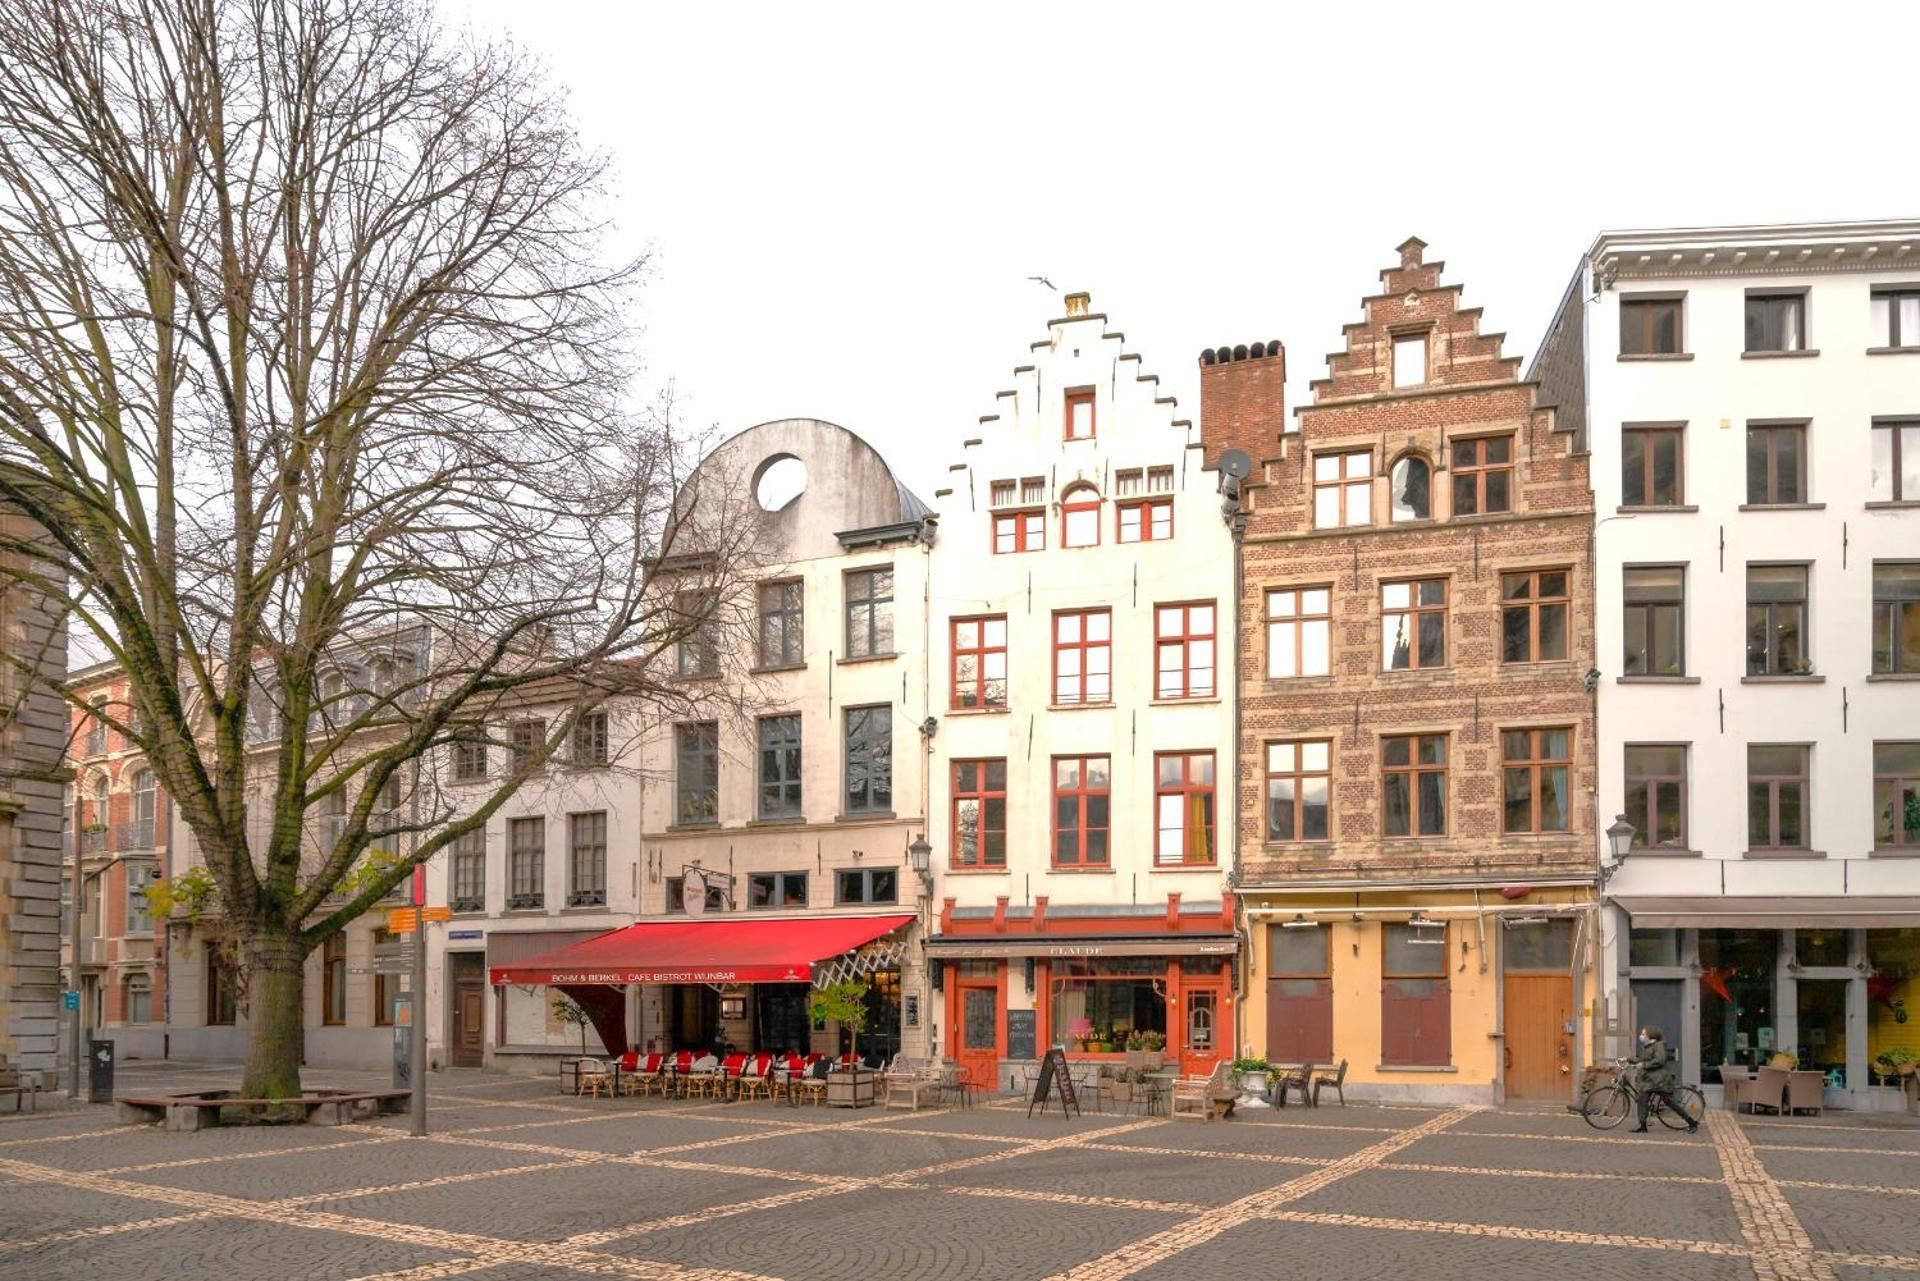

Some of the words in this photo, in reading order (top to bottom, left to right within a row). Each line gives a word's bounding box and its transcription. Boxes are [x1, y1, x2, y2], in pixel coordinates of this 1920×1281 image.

[1049, 946, 1104, 955] CLAUDE
[588, 974, 624, 982] BERKEL
[653, 972, 692, 981] BISTROT
